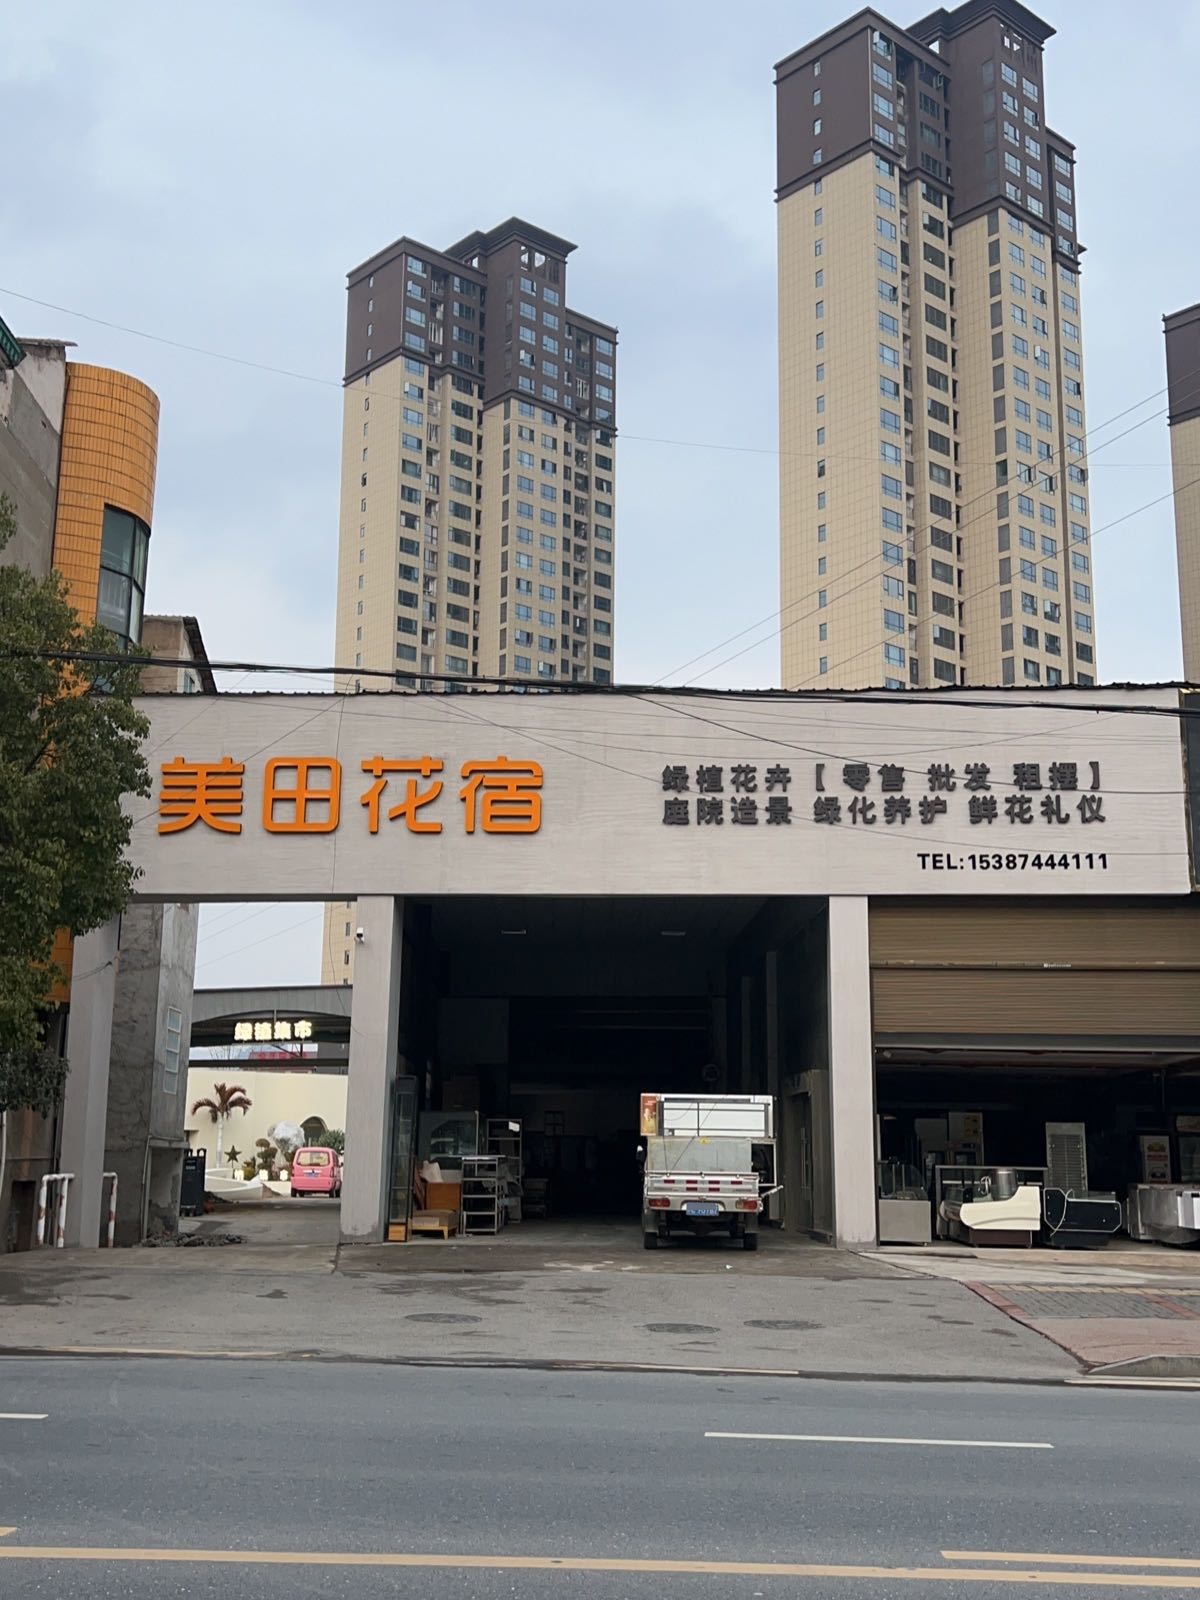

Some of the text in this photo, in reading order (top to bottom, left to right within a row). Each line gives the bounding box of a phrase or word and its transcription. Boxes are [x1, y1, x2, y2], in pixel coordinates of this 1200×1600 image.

[662, 763, 792, 793] 绿植花卉
[928, 763, 992, 792] 批发
[157, 755, 544, 835] 美田花宿
[662, 794, 1107, 826] 庭院造景 绿化养护 鲜花礼仪
[917, 853, 1108, 870] TEL:15387444111
